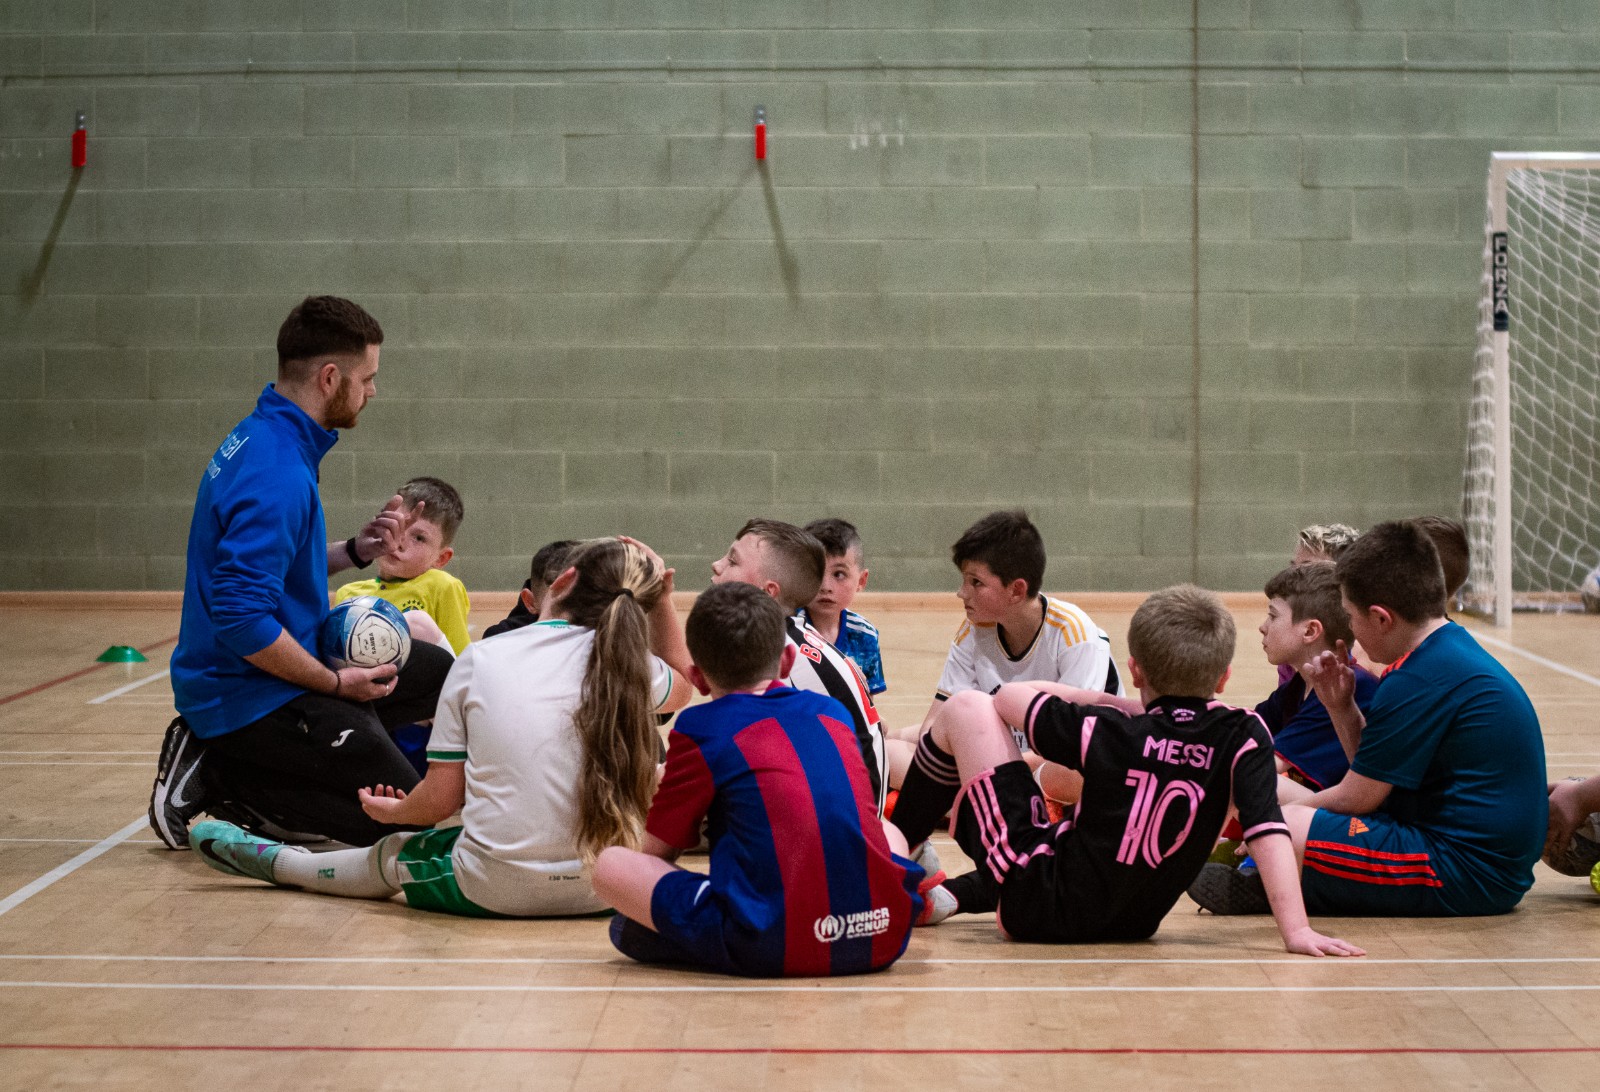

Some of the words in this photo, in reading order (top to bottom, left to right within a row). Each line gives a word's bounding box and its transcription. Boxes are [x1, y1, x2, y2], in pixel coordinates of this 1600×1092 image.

[369, 632, 377, 655] SAMBA
[1142, 735, 1215, 770] MESSI
[1116, 769, 1206, 869] 10
[846, 907, 890, 924] UNHCR
[846, 918, 890, 934] ACNUR
